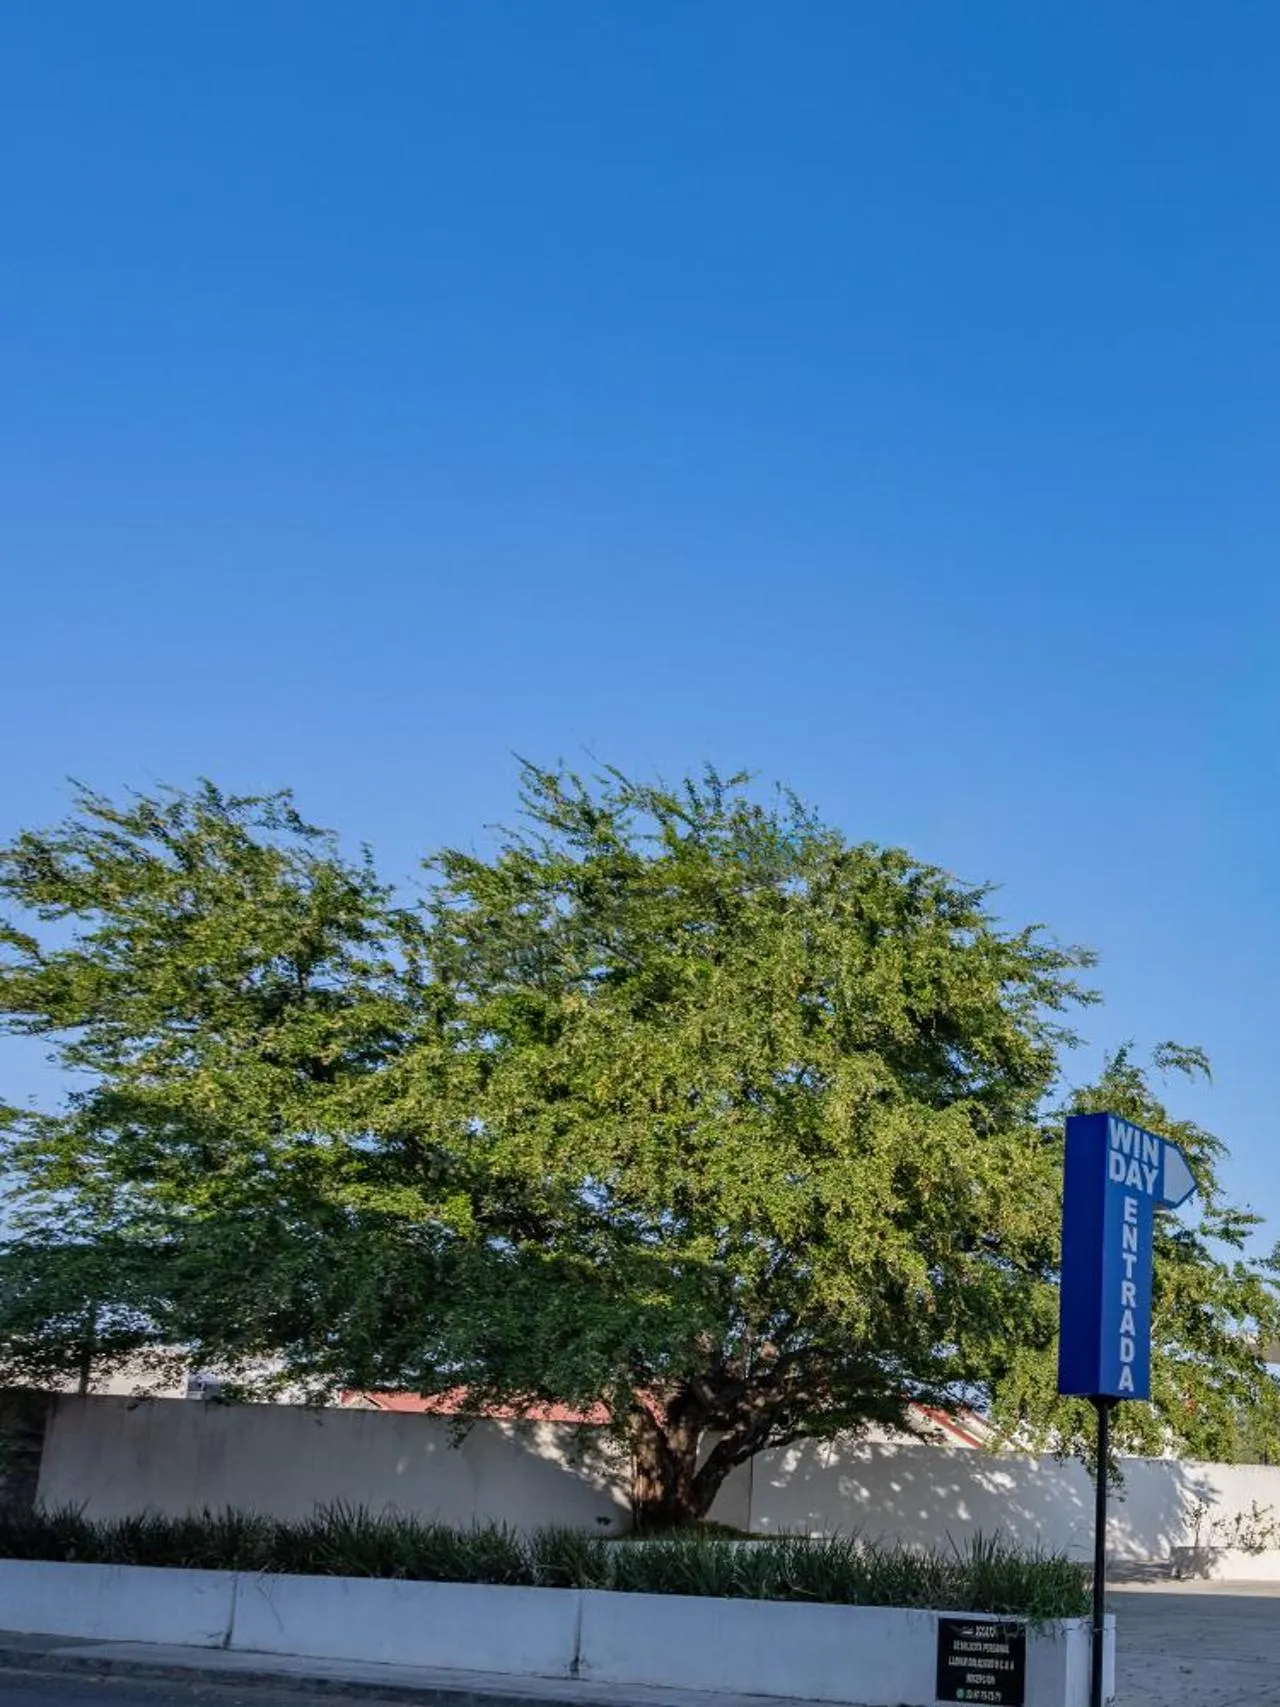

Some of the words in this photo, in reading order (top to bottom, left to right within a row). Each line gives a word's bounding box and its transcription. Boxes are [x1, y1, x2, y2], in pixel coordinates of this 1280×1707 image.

[1109, 1117, 1160, 1167] WIN
[1109, 1150, 1159, 1196] DAY
[1118, 1195, 1139, 1392] ENTRADA
